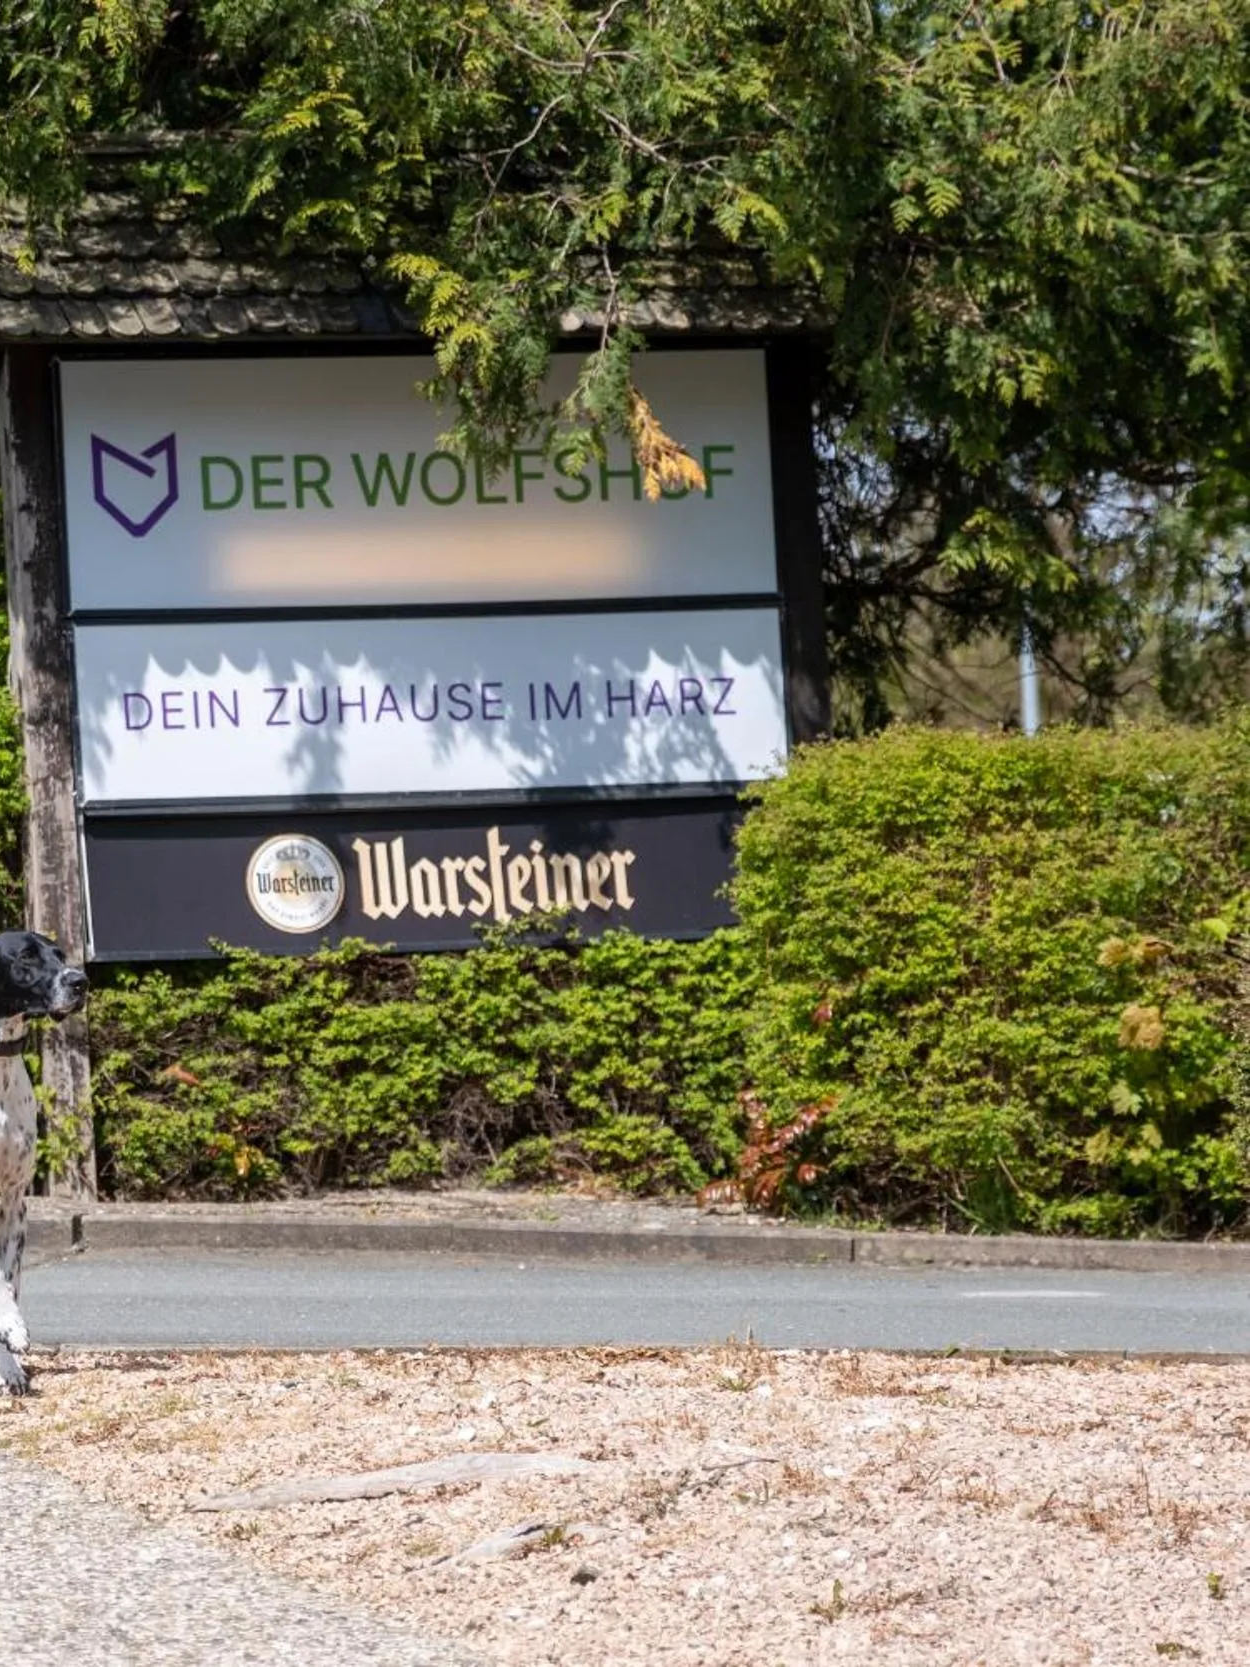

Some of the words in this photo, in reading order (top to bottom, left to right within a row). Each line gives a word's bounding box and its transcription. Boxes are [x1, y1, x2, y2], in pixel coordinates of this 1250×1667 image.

[200, 454, 334, 511] DER
[350, 445, 734, 507] WOLFSHF
[123, 690, 240, 730] DEIN
[264, 682, 504, 726] ZUHAUSE
[528, 682, 582, 721] IM
[606, 677, 737, 717] HARZ
[256, 868, 335, 897] Warsteiner
[351, 825, 636, 923] Warsteiner
